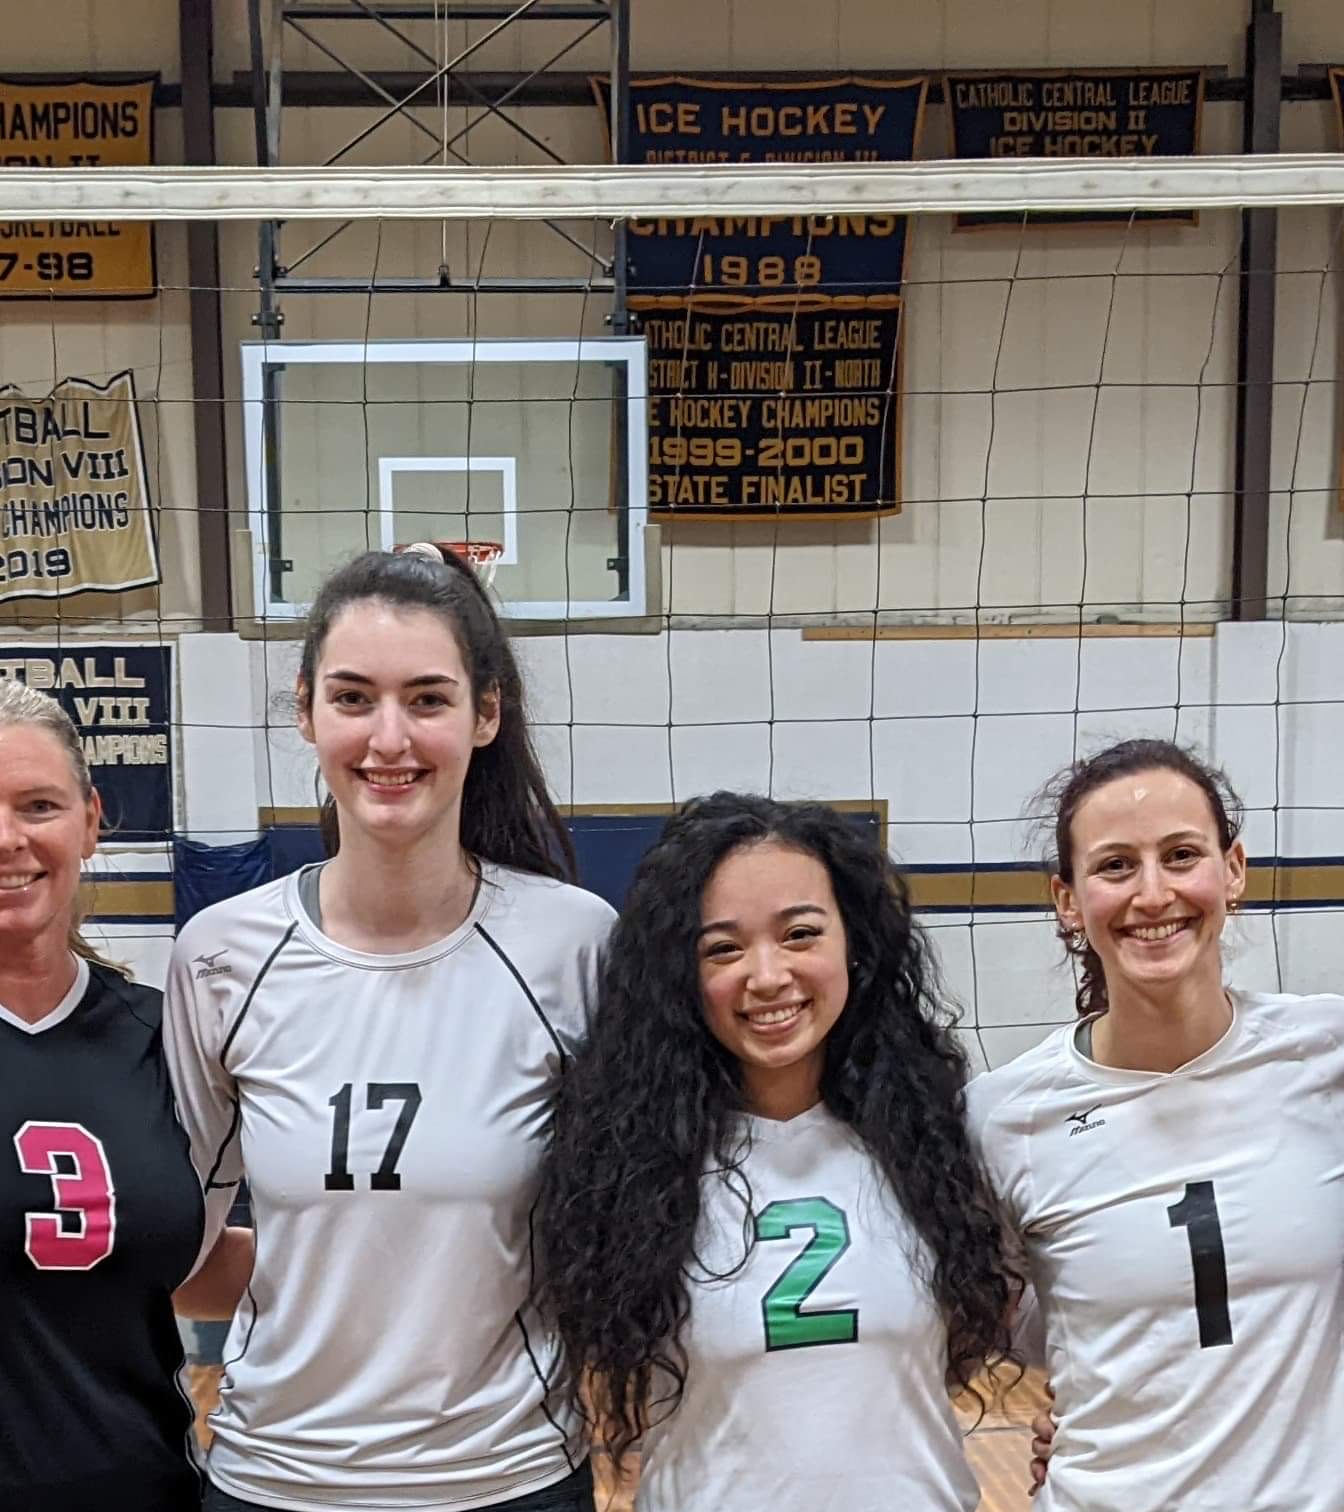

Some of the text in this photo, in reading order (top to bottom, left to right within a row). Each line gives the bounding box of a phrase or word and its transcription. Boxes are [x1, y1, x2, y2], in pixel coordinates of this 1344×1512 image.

[956, 79, 1192, 109] CATHOLIC CENTRAL LEAGUE
[636, 102, 886, 137] ICE HOCKEY
[1003, 110, 1117, 132] DIVISION
[988, 133, 1159, 157] ICE HOCKEY
[645, 319, 883, 352] ATHOLIC CENTRAL LEAGUE
[649, 359, 699, 390] STRICT
[669, 398, 753, 429] HOCKEY
[761, 396, 881, 428] CHAMPIONS
[61, 449, 129, 480] VIII
[649, 435, 865, 467] 1999-2000
[648, 473, 867, 505] STATE FINALIST
[72, 696, 151, 728] VIII
[77, 734, 167, 767] AMPIONS
[324, 1082, 423, 1191] 17
[13, 1120, 116, 1271] 3
[753, 1196, 859, 1352] 2
[1167, 1180, 1234, 1349] 1
